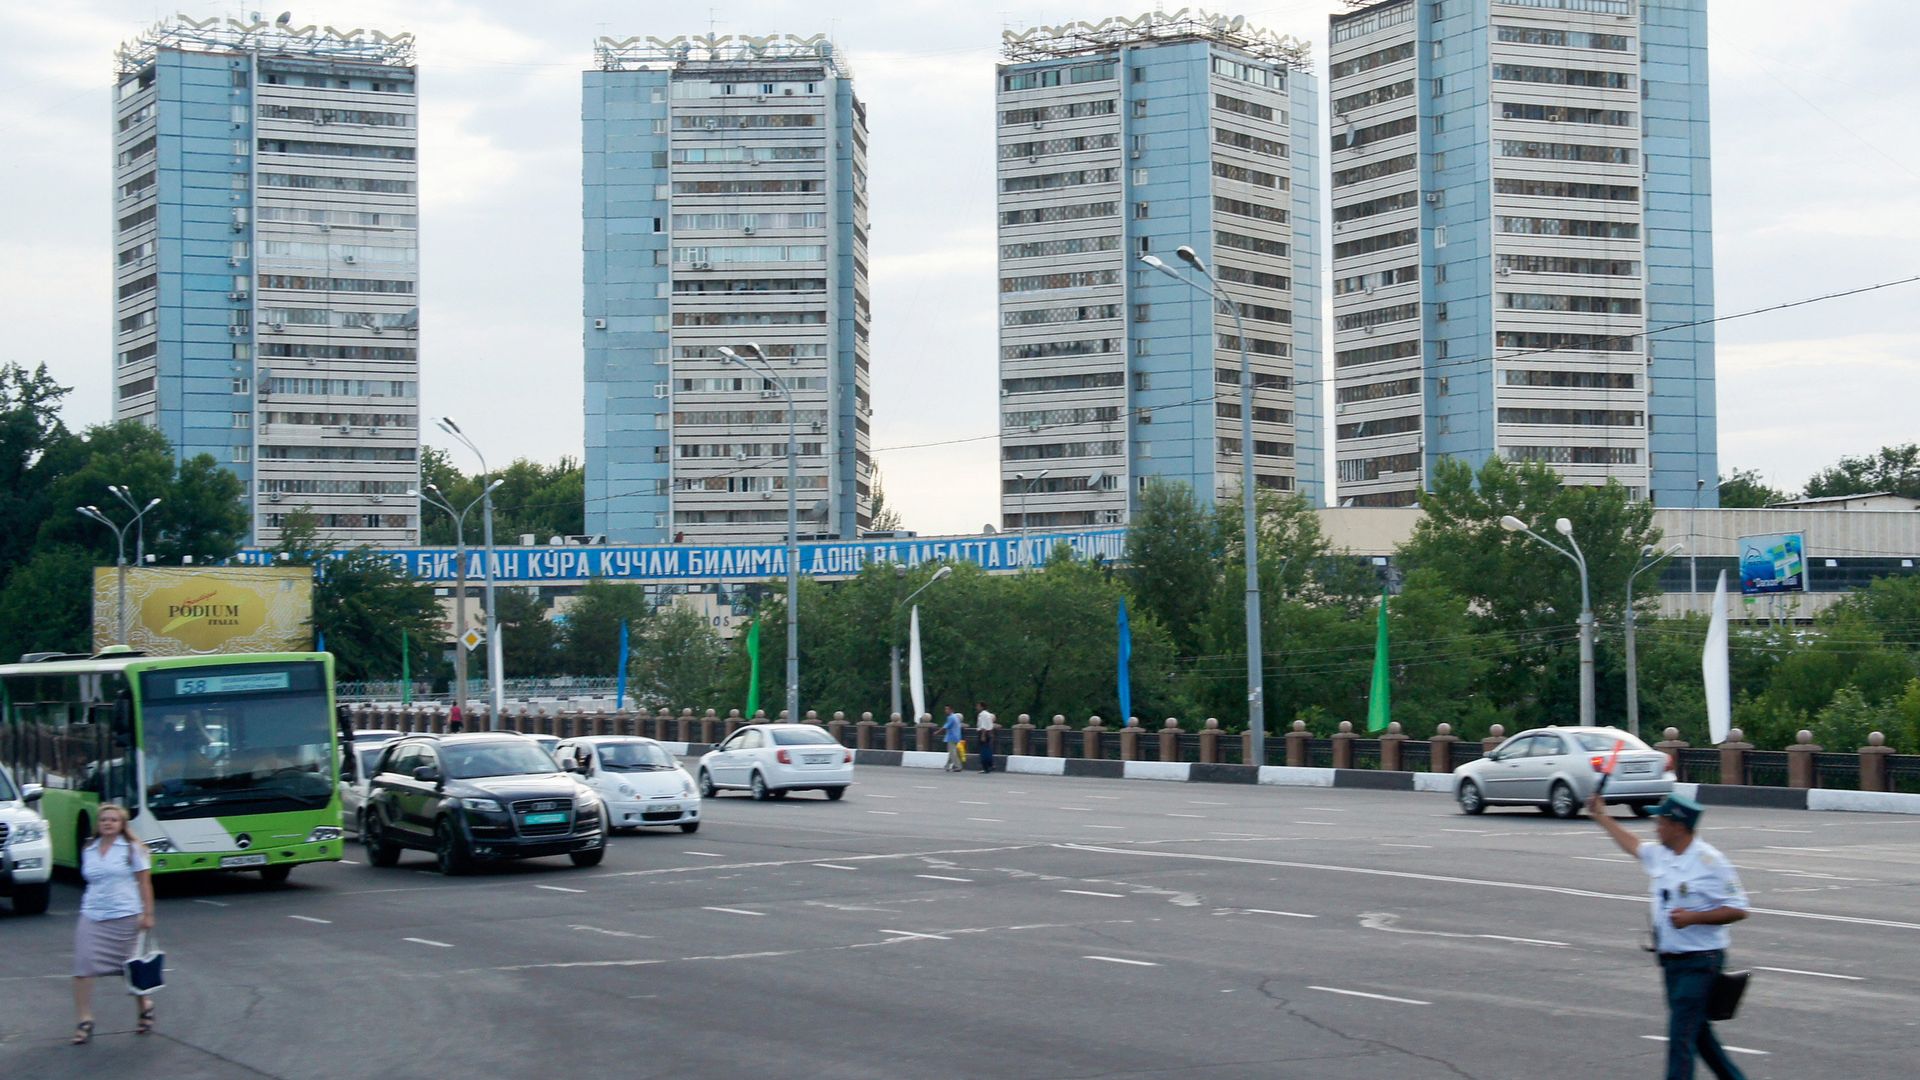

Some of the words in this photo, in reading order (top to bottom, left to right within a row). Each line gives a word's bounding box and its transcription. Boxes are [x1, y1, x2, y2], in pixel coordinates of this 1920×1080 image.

[417, 552, 519, 578] БИЗДАН
[527, 549, 590, 577] КЎРА
[168, 604, 239, 618] PODIUM
[182, 681, 207, 695] 58
